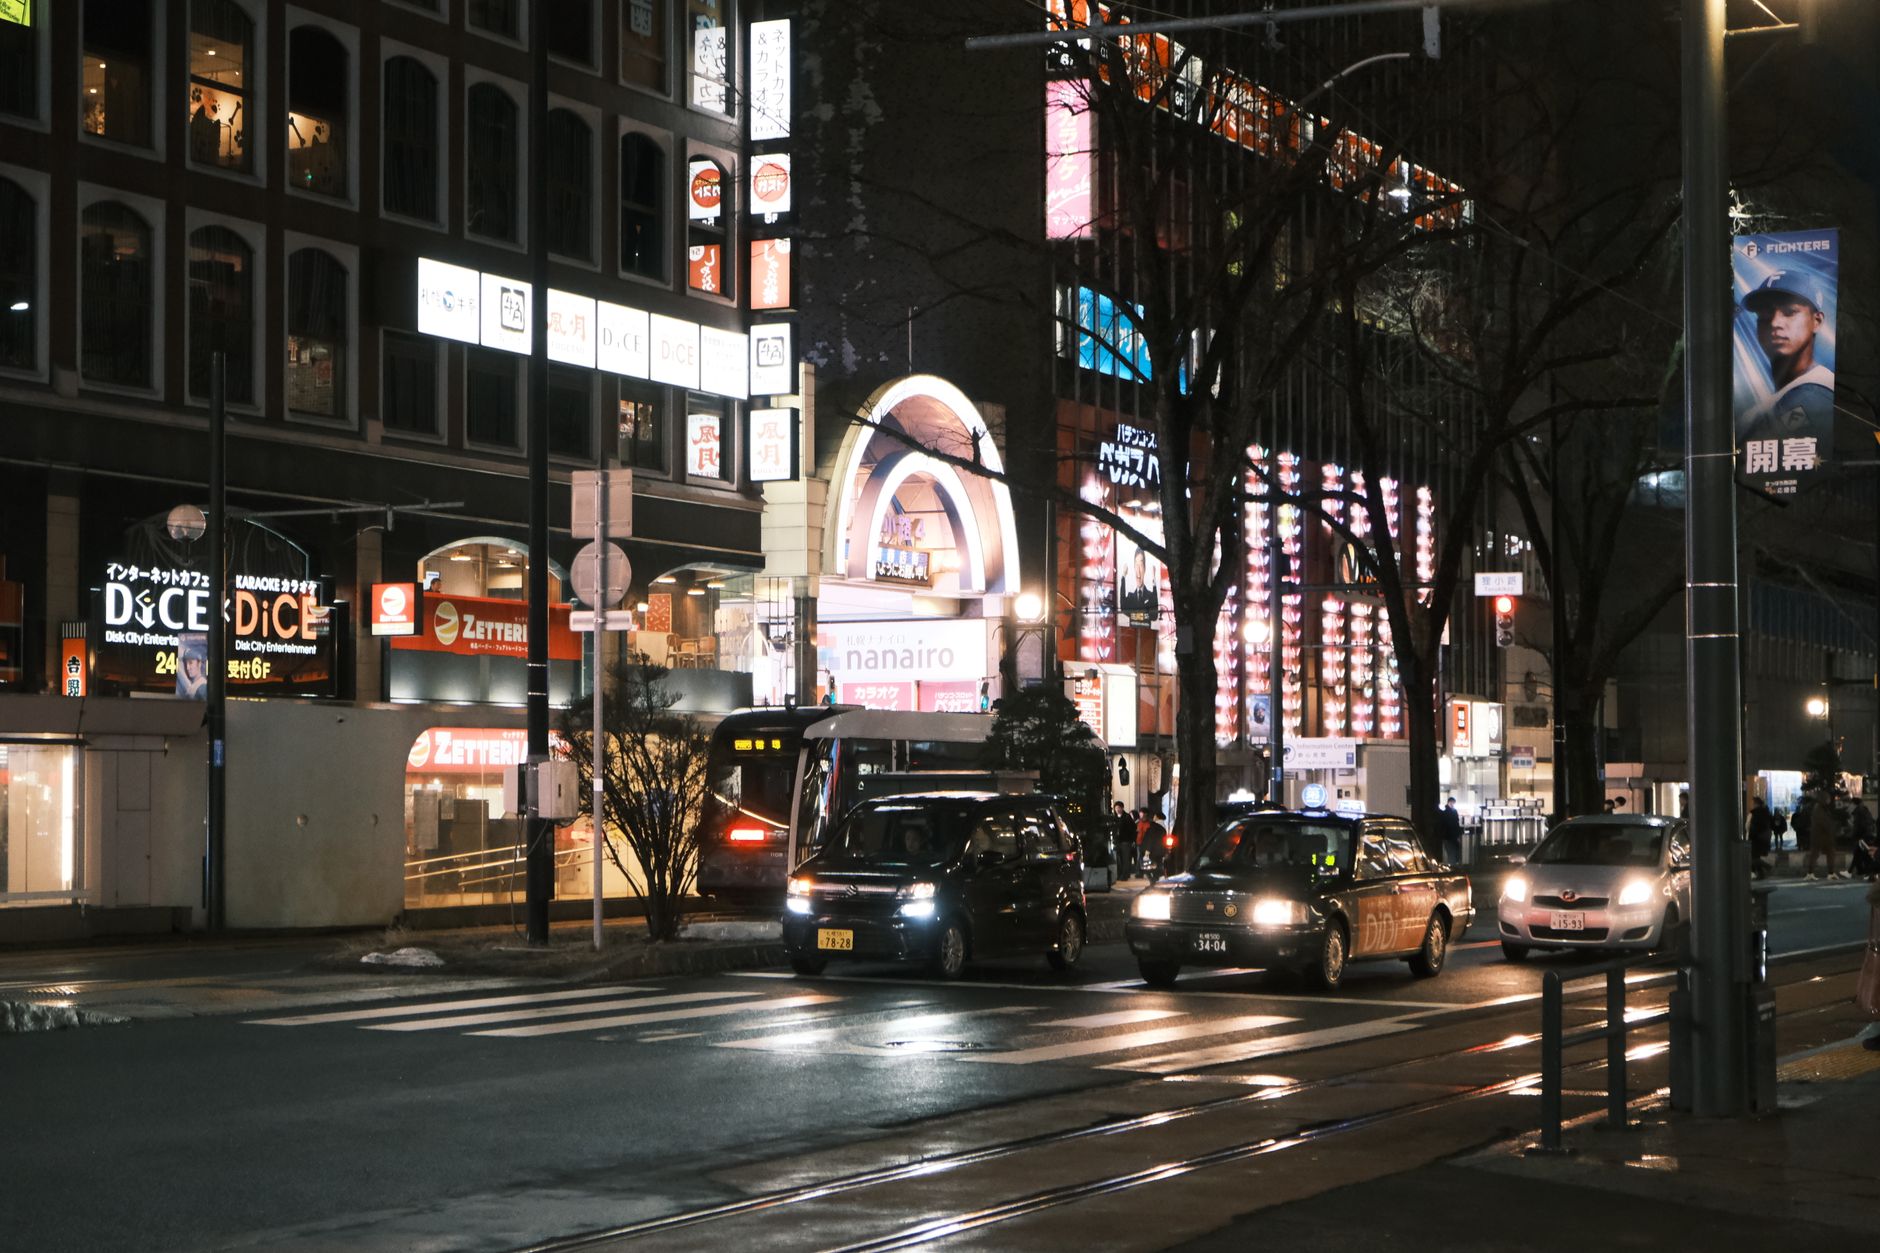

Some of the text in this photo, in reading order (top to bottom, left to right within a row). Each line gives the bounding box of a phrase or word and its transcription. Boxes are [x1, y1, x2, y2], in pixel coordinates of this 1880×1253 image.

[756, 32, 769, 119] &カラオケ
[772, 28, 786, 119] ネットカフェ
[1766, 239, 1830, 254] FIGHTERS
[547, 311, 587, 342] 風月
[756, 422, 786, 467] 風月
[1746, 437, 1818, 474] 開幕
[106, 563, 210, 588] インターネットカフェ
[235, 574, 317, 596] KARAOKE カラオケ
[235, 590, 318, 640] DiCE
[105, 630, 125, 643] Disk
[125, 631, 144, 646] City
[235, 640, 317, 655] Disk City Entertainment
[846, 639, 955, 671] nanairo
[855, 686, 900, 701] カラオケ
[1333, 742, 1354, 750] Center
[1363, 912, 1399, 952] DiDi
[1558, 919, 1582, 929] 15-93
[825, 937, 851, 949] 78-28
[1198, 940, 1227, 952] 34-04
